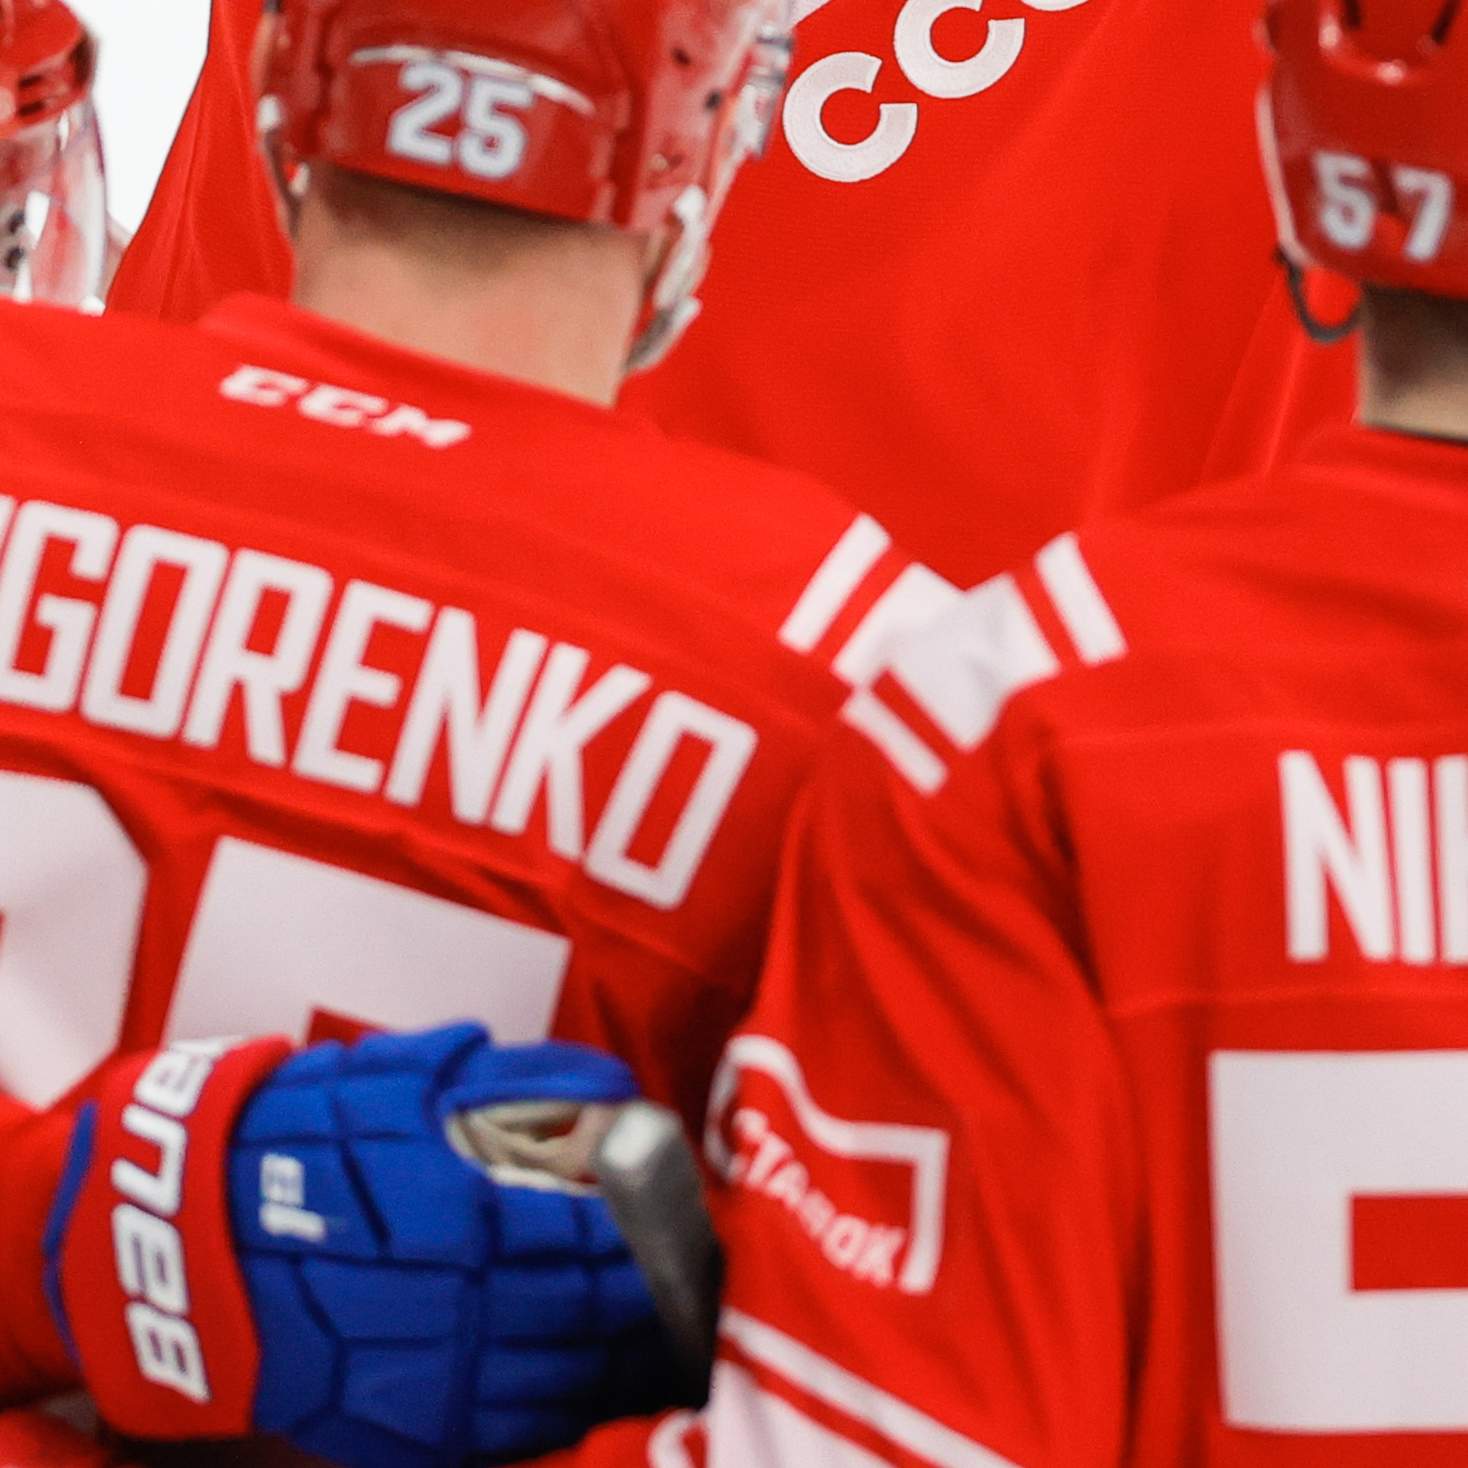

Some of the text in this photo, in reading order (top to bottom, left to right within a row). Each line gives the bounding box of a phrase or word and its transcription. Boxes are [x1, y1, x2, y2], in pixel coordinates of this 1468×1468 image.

[386, 60, 533, 180] 25
[1310, 151, 1453, 263] 57
[219, 363, 475, 450] CCM
